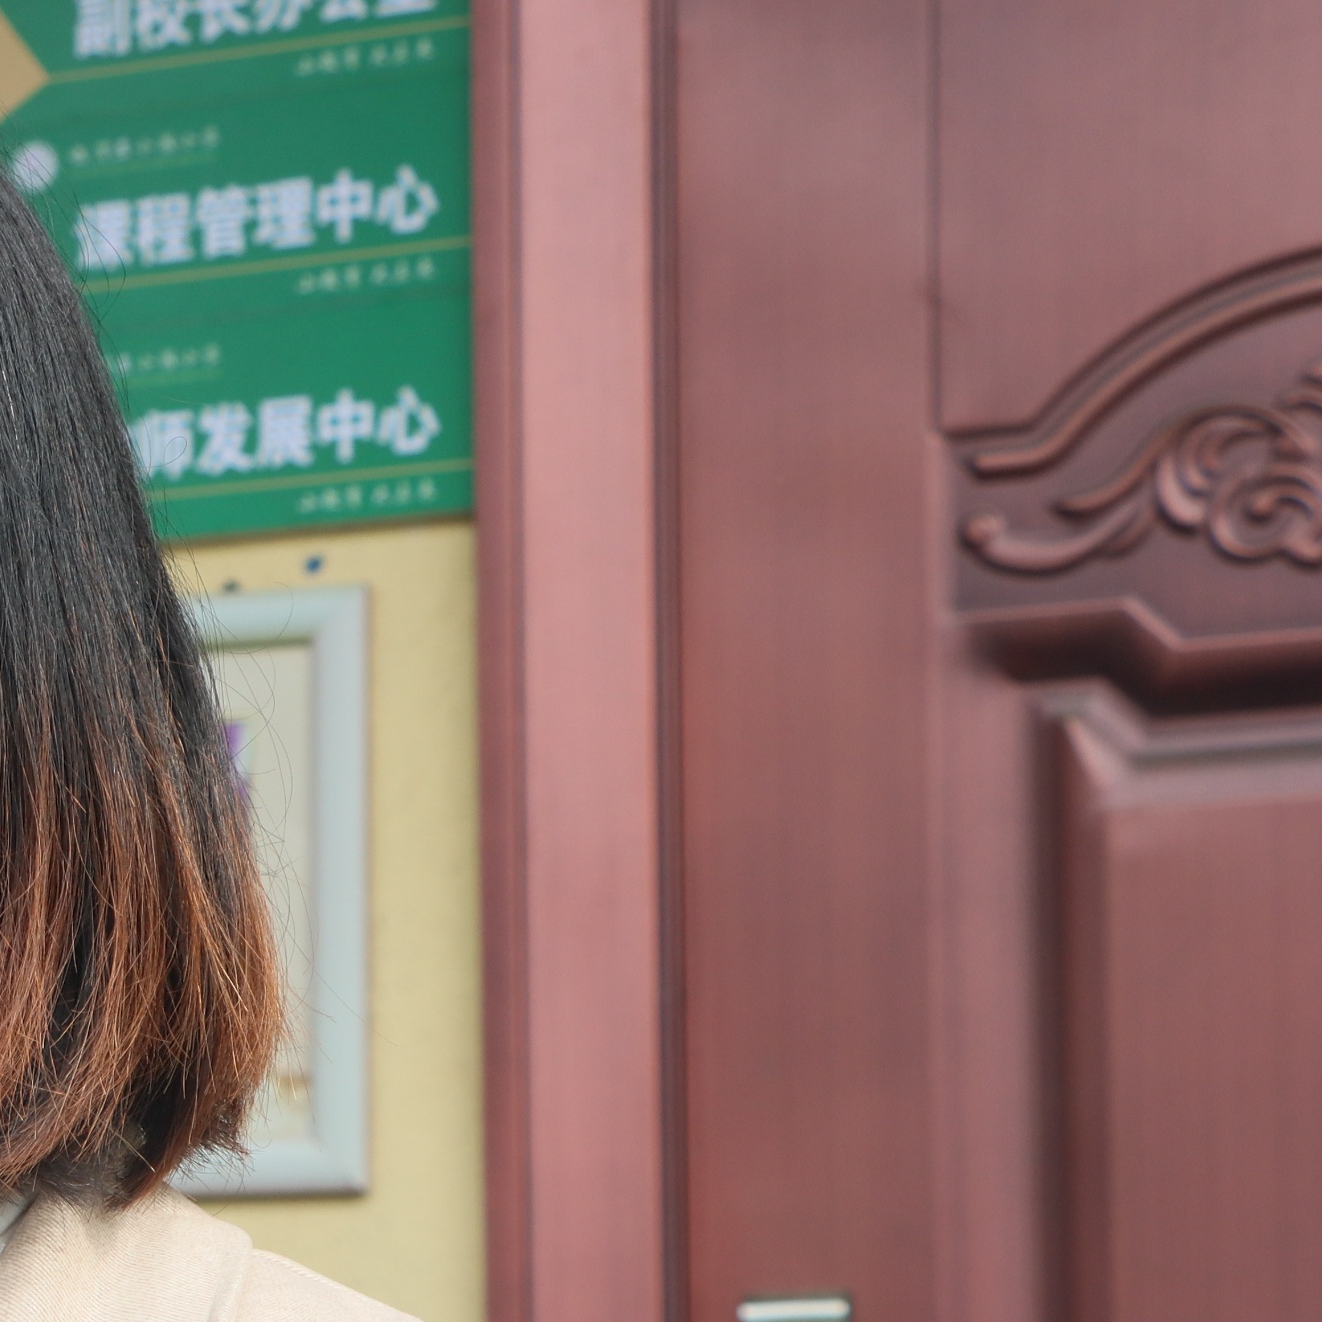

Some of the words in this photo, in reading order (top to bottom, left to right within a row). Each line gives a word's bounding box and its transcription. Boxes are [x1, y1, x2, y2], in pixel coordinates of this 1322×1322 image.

[72, 0, 438, 58] 副校长
[74, 164, 438, 271] 课程管理中心
